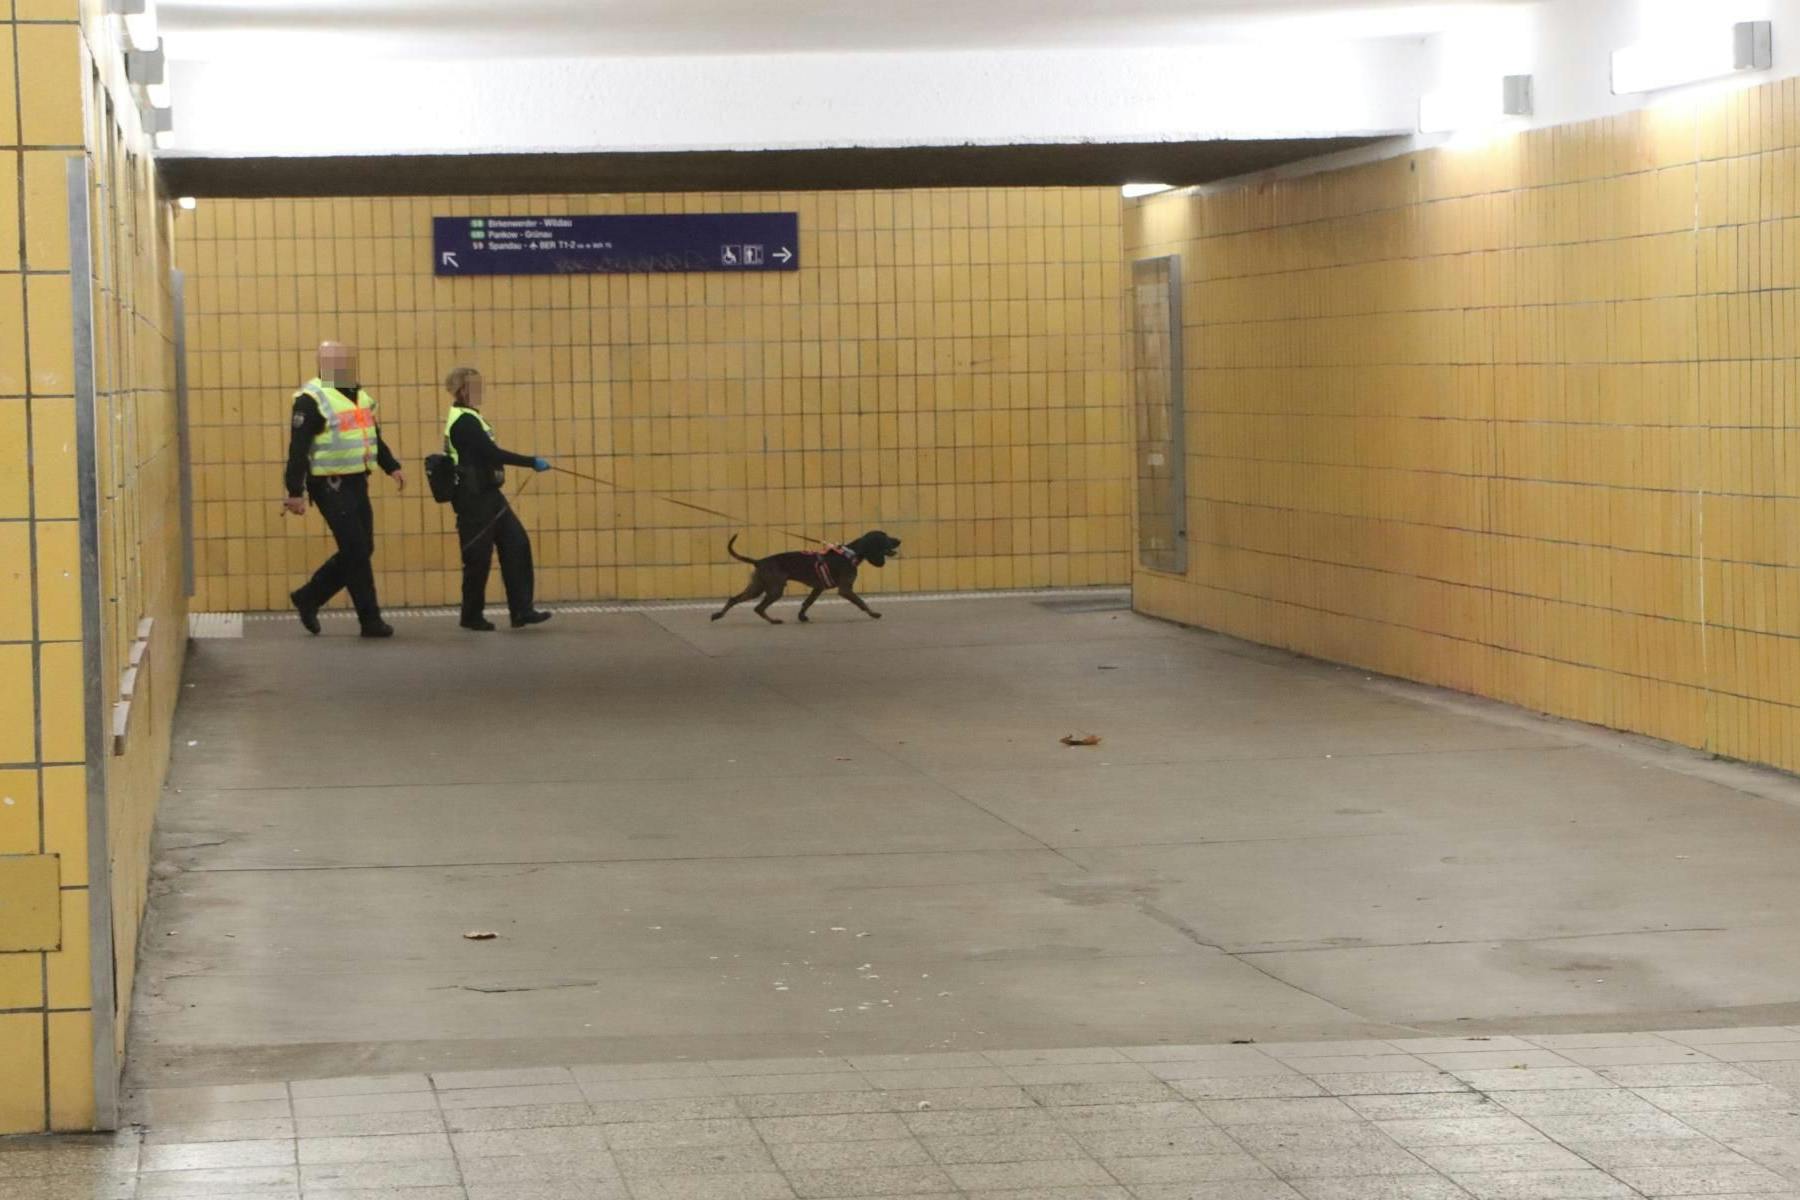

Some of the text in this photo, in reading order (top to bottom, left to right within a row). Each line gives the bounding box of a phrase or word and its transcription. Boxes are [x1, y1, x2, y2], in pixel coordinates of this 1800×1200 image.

[543, 219, 573, 227] Wildau
[488, 231, 518, 239] Pankow
[525, 230, 553, 238] Grünau
[488, 241, 522, 251] Spandau
[539, 241, 556, 249] BER
[559, 240, 577, 249] T1-2
